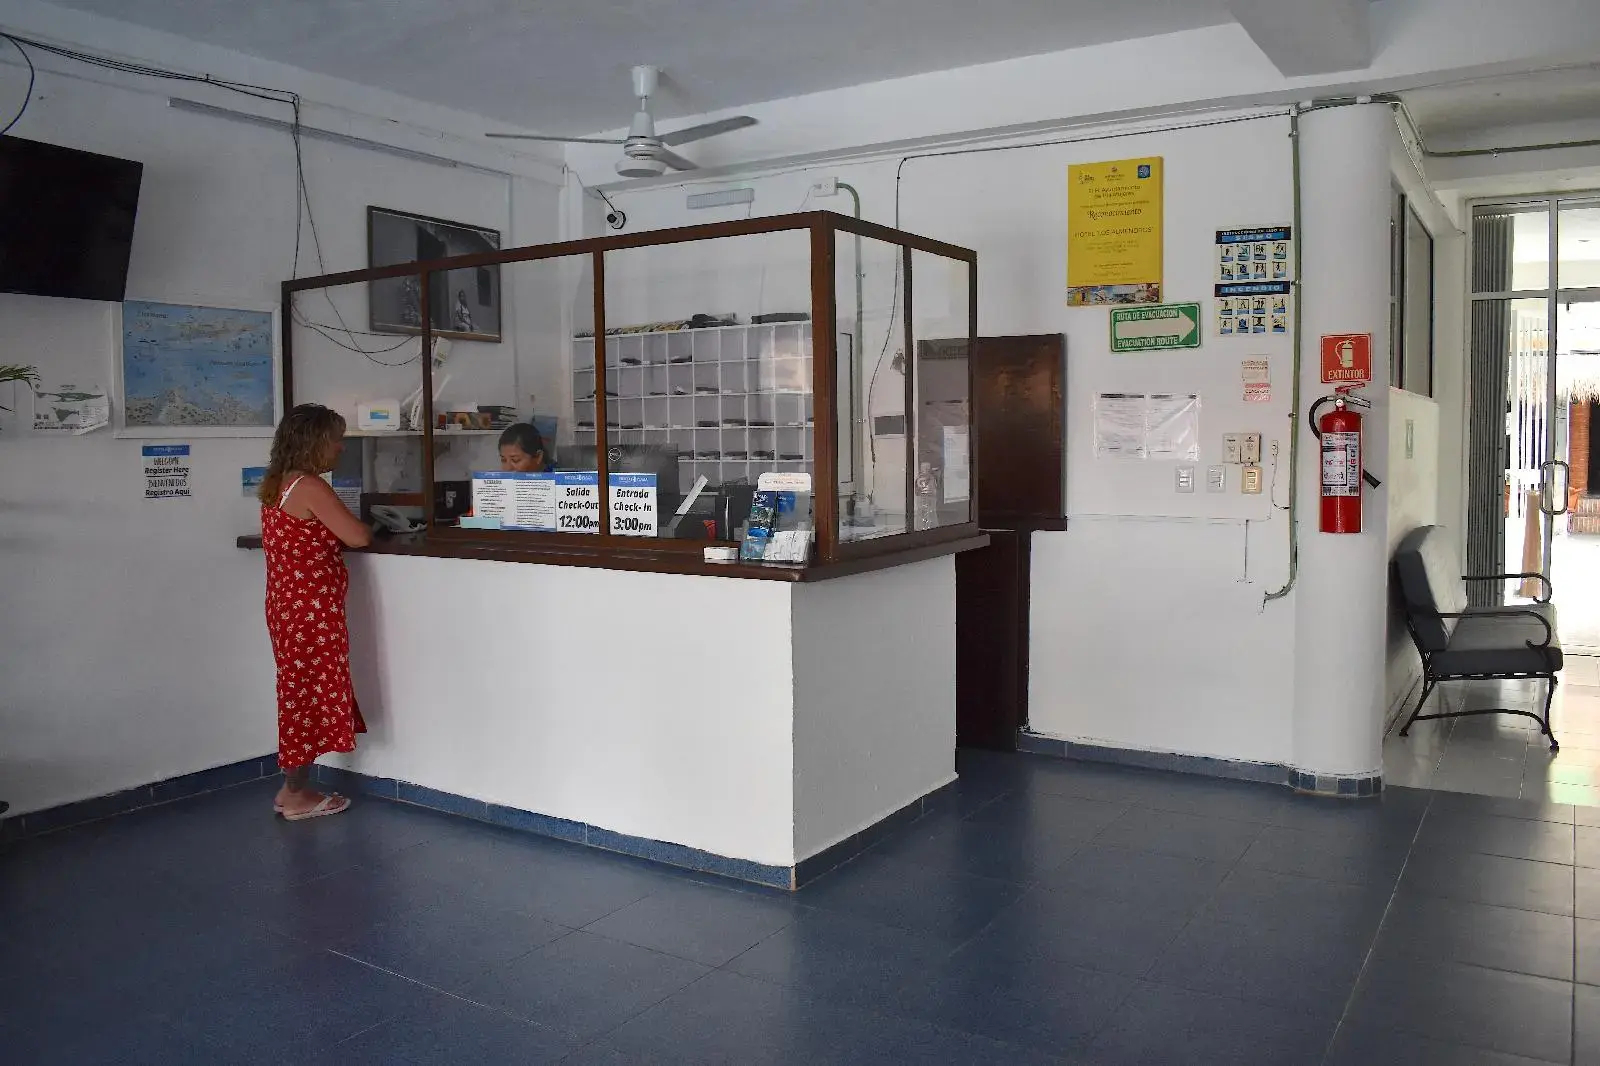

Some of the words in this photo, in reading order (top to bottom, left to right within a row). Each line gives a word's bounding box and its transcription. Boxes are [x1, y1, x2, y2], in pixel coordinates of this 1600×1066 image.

[1235, 233, 1272, 241] SISMO
[1225, 284, 1280, 293] INCENDIO
[1116, 312, 1132, 321] RUTA
[1132, 311, 1140, 320] DE
[1117, 337, 1155, 348] EVACUATION
[1156, 336, 1178, 346] ROUTE
[1328, 368, 1365, 380] EXTINTOR
[145, 467, 172, 475] Register
[566, 487, 590, 497] Salida
[616, 488, 649, 499] Entrada
[558, 501, 599, 510] Check-Out
[559, 515, 600, 529] 12:00pm
[613, 516, 652, 532] 3:00pm
